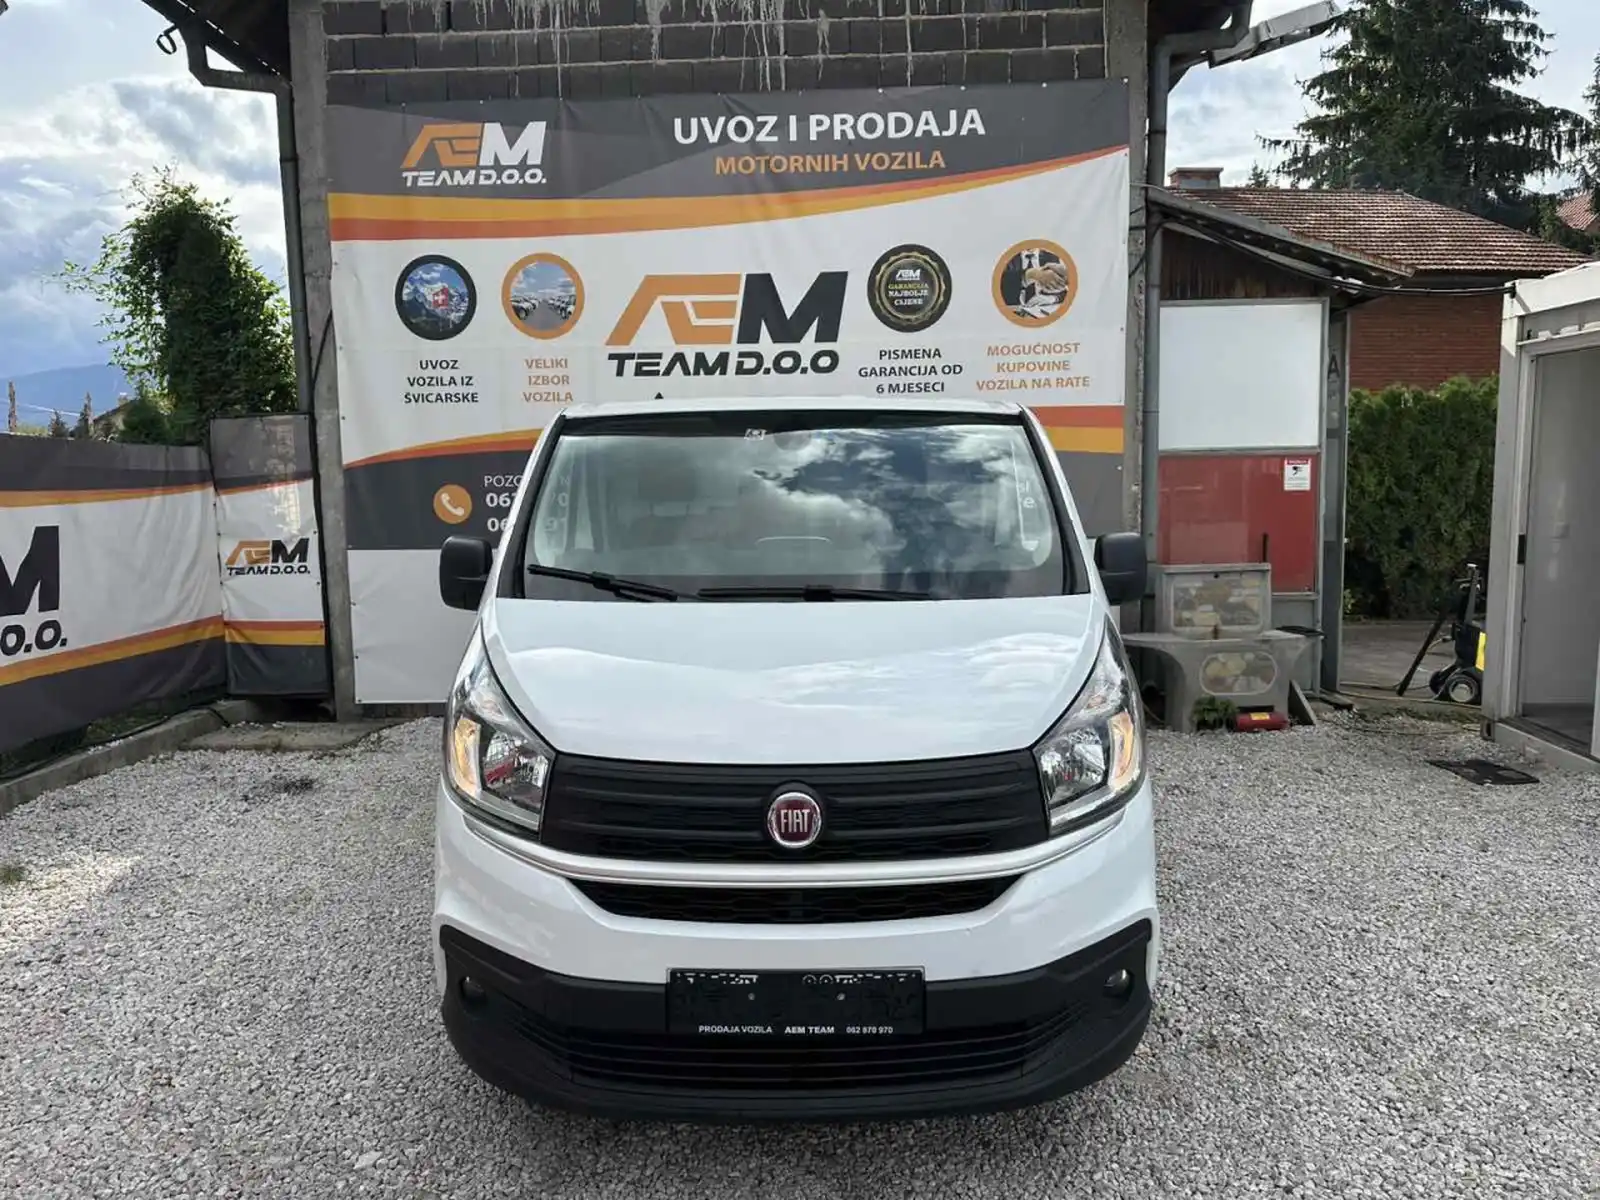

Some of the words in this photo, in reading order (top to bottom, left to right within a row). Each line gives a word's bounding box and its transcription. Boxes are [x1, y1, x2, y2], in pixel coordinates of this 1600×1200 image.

[674, 115, 778, 144] UVOZ
[788, 115, 797, 142] I
[809, 108, 986, 141] PRODAJA
[715, 153, 849, 175] MOTORNIH
[854, 150, 946, 171] VOZILA
[402, 169, 476, 187] TEAM
[879, 348, 942, 360] PISMENA
[987, 342, 1081, 357] MOGUĆNOST
[419, 359, 459, 370] UVOZ
[525, 358, 568, 369] VELIKI
[608, 352, 730, 377] TEAM
[996, 360, 1071, 373] KUPOVINE
[858, 366, 937, 378] GARANCIJA
[941, 364, 963, 375] OD
[407, 376, 456, 387] VOZILA
[460, 376, 473, 386] IZ
[528, 375, 570, 386] IZBOR
[976, 379, 1028, 391] VOZILA
[1031, 378, 1052, 389] NA
[1056, 376, 1090, 388] RATE
[876, 383, 885, 394] 6
[887, 381, 945, 394] MJESECI
[404, 391, 479, 404] ŠVICARSKE
[523, 391, 573, 402] VOZILA
[484, 475, 523, 487] POZO
[780, 809, 810, 832] FIAT
[698, 1025, 740, 1034] PRODAJA
[741, 1025, 773, 1034] VOZILA
[784, 1025, 806, 1035] AEM
[808, 1025, 835, 1035] TEAM
